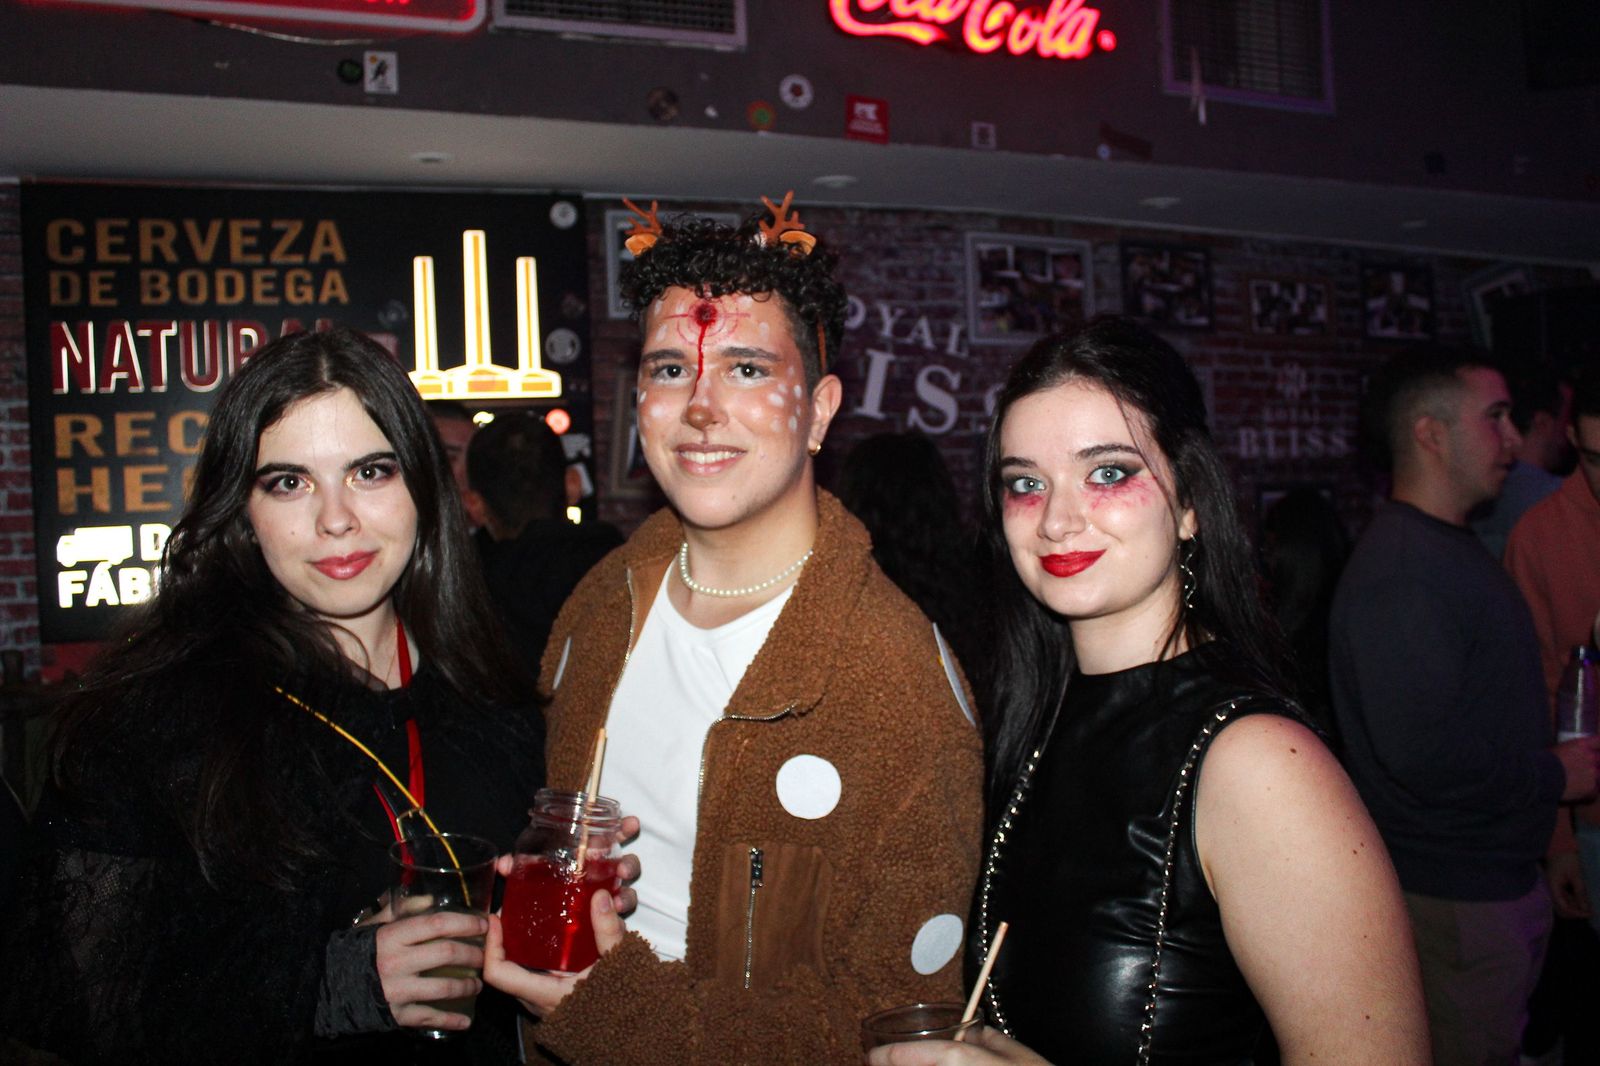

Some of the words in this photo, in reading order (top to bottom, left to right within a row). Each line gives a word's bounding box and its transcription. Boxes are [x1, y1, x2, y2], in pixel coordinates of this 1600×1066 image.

[47, 218, 347, 264] CERVEZA
[50, 269, 119, 306] DE
[140, 267, 350, 305] BODEGA
[844, 294, 970, 361] OYAL
[49, 319, 334, 394] NATUR
[54, 411, 210, 458] REC
[56, 465, 199, 515] HE
